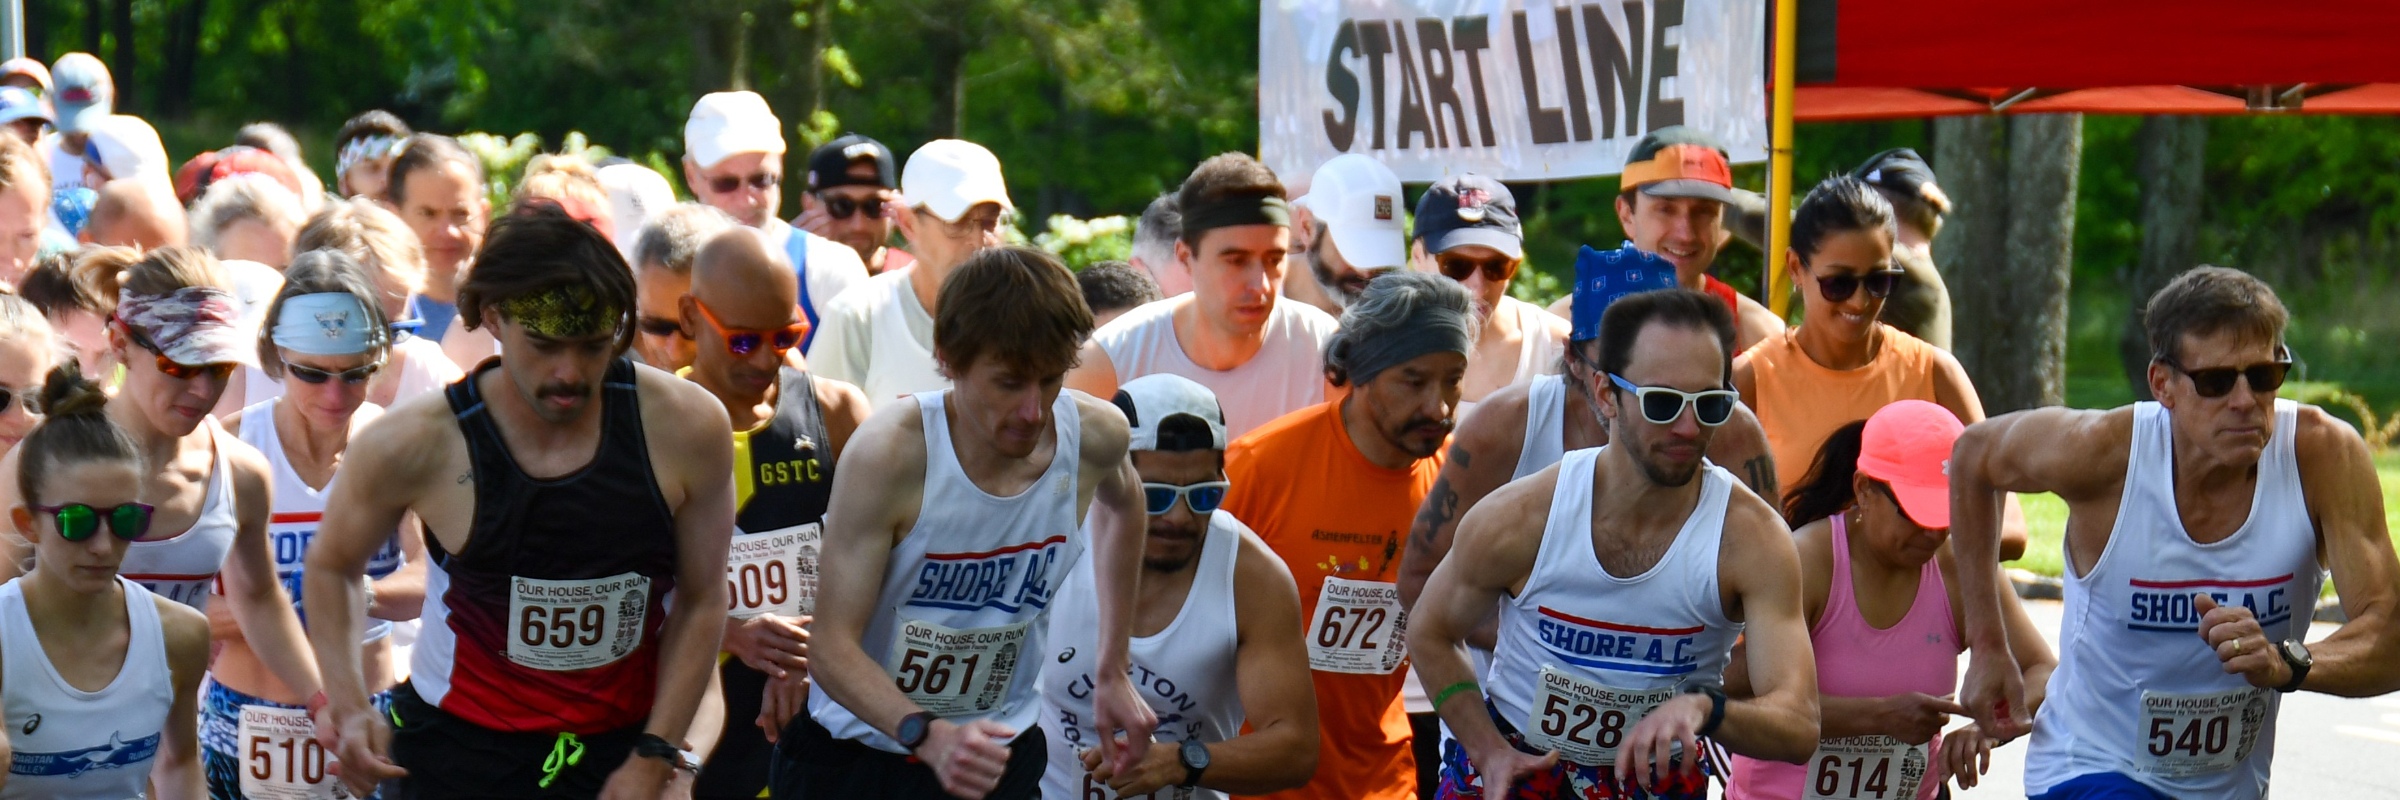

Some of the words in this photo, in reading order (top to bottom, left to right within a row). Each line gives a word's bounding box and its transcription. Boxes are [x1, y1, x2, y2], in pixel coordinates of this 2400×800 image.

[1322, 15, 1496, 152] START
[1512, 0, 1685, 145] LINE
[760, 458, 821, 484] GSTC
[731, 539, 771, 553] HOUSE,
[772, 535, 794, 548] OUR
[797, 529, 818, 542] RUN
[517, 583, 544, 596] OUR
[548, 586, 593, 597] HOUSE,
[595, 582, 621, 594] OUR
[624, 576, 647, 589] RUN
[912, 557, 1016, 602] SHORE
[1013, 546, 1056, 603] AC.
[1328, 584, 1350, 596] OUR
[1352, 587, 1383, 599] HOUSE,
[2131, 592, 2228, 623] SHOE
[2243, 588, 2290, 619] A.C.
[520, 604, 605, 648] 659
[906, 625, 932, 640] OUR
[935, 632, 975, 645] HOUSE,
[978, 633, 1002, 643] OUR
[1004, 627, 1026, 641] RUN
[1318, 606, 1386, 650] 672
[905, 637, 933, 649] Sponsored
[1539, 619, 1637, 659] SHORE
[1644, 637, 1696, 665] A.C.
[896, 648, 980, 695] 561
[1545, 673, 1570, 689] OUR
[1573, 683, 1616, 702] HOUSE,
[1619, 694, 1645, 704] OUR
[1648, 692, 1673, 704] RUN
[1545, 683, 1573, 697] Sponsored
[1574, 693, 1581, 701] By
[1594, 699, 1612, 707] Martin
[1613, 702, 1631, 710] Family
[2146, 697, 2172, 708] OUR
[2177, 697, 2220, 708] HOUSE,
[245, 711, 268, 724] OUR
[271, 715, 312, 728] HOUSE,
[1541, 694, 1626, 749] 528
[1845, 736, 1882, 748] HOUSE,
[2148, 715, 2229, 757] 540
[11, 764, 45, 774] VALLEY
[12, 754, 54, 764] RARITAN
[249, 735, 325, 785] 510
[1816, 755, 1890, 800] 614
